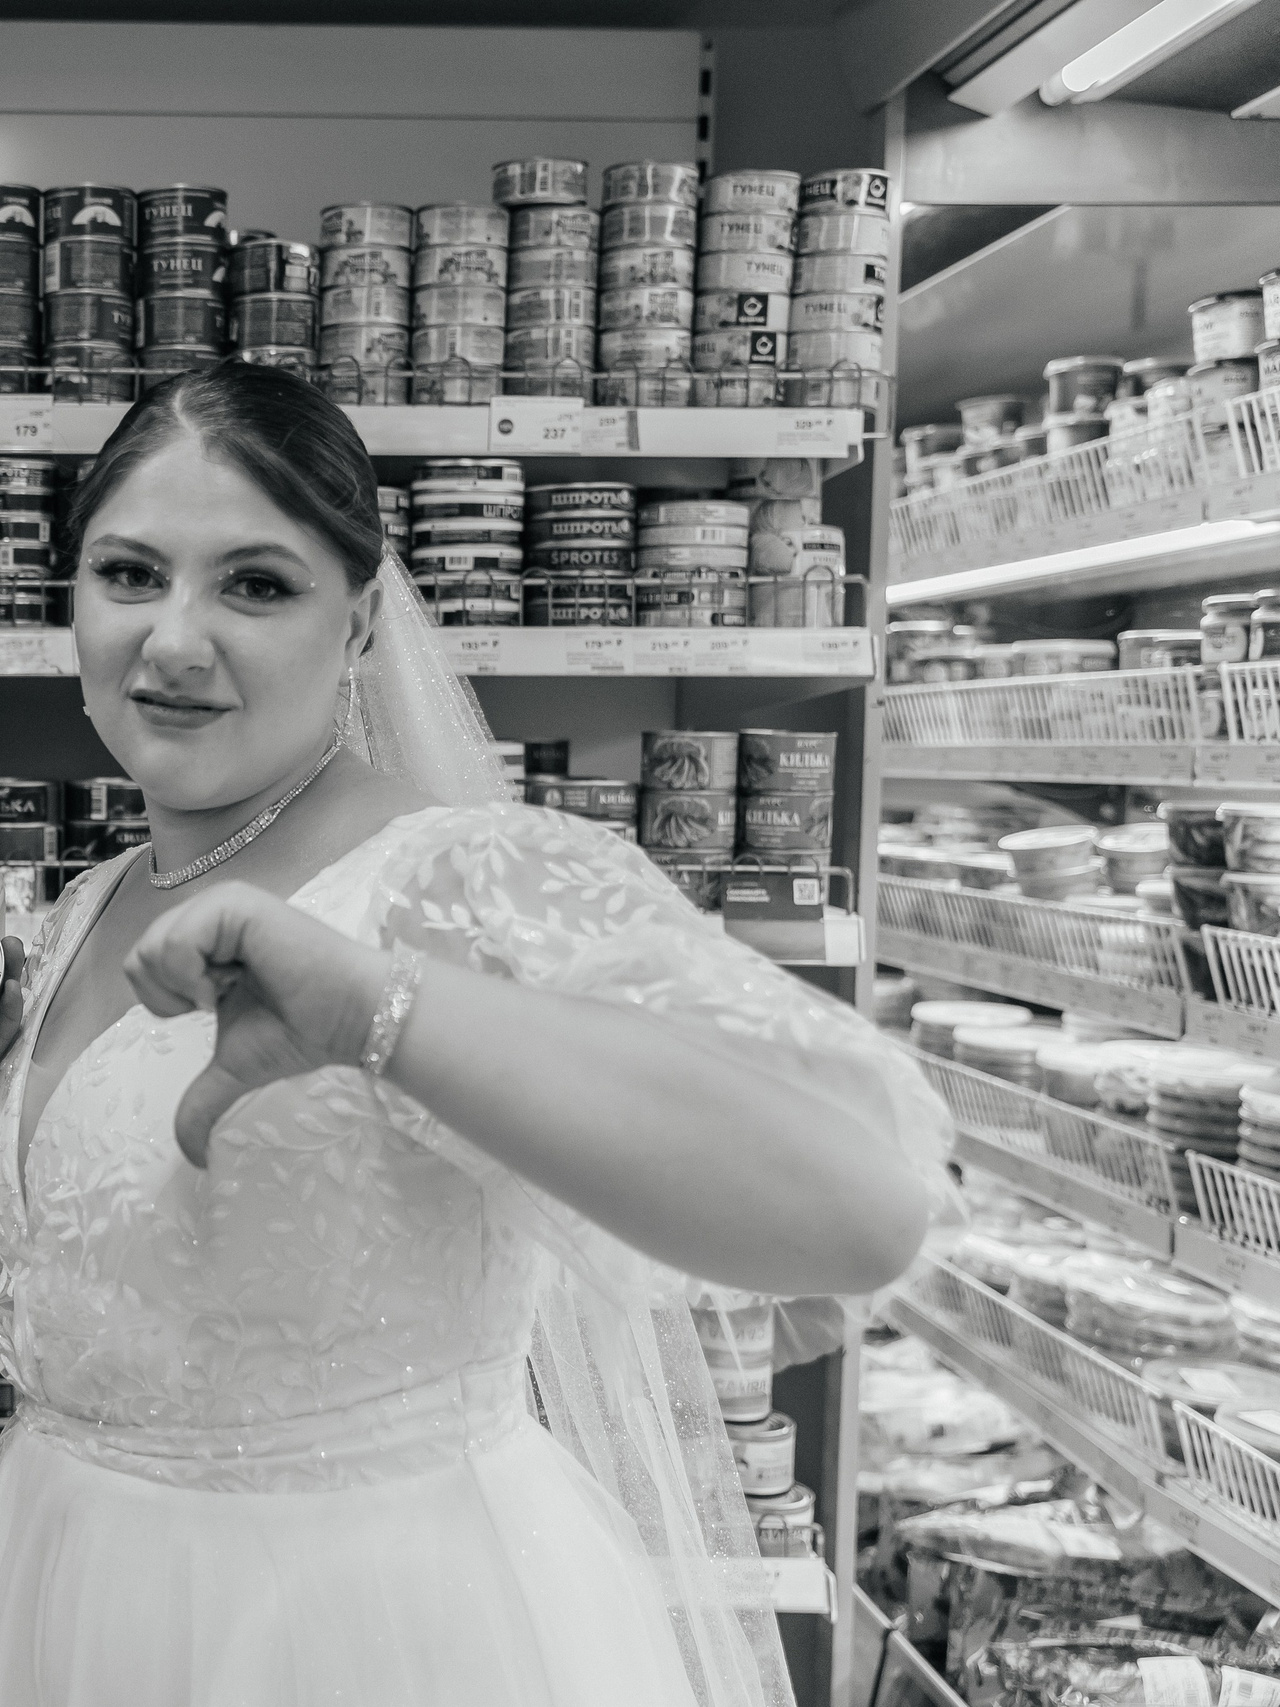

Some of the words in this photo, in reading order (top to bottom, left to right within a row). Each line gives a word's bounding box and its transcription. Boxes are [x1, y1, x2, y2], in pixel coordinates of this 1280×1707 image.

[144, 204, 193, 220] ТУНЕЦ
[152, 258, 203, 273] ТУНЕЦ
[15, 425, 38, 437] 179
[543, 428, 566, 440] 237
[551, 490, 628, 506] ШПРОТЫ
[483, 503, 521, 519] ШПРО
[552, 519, 629, 536] ШПРОТЫ
[551, 550, 618, 566] SPROTES
